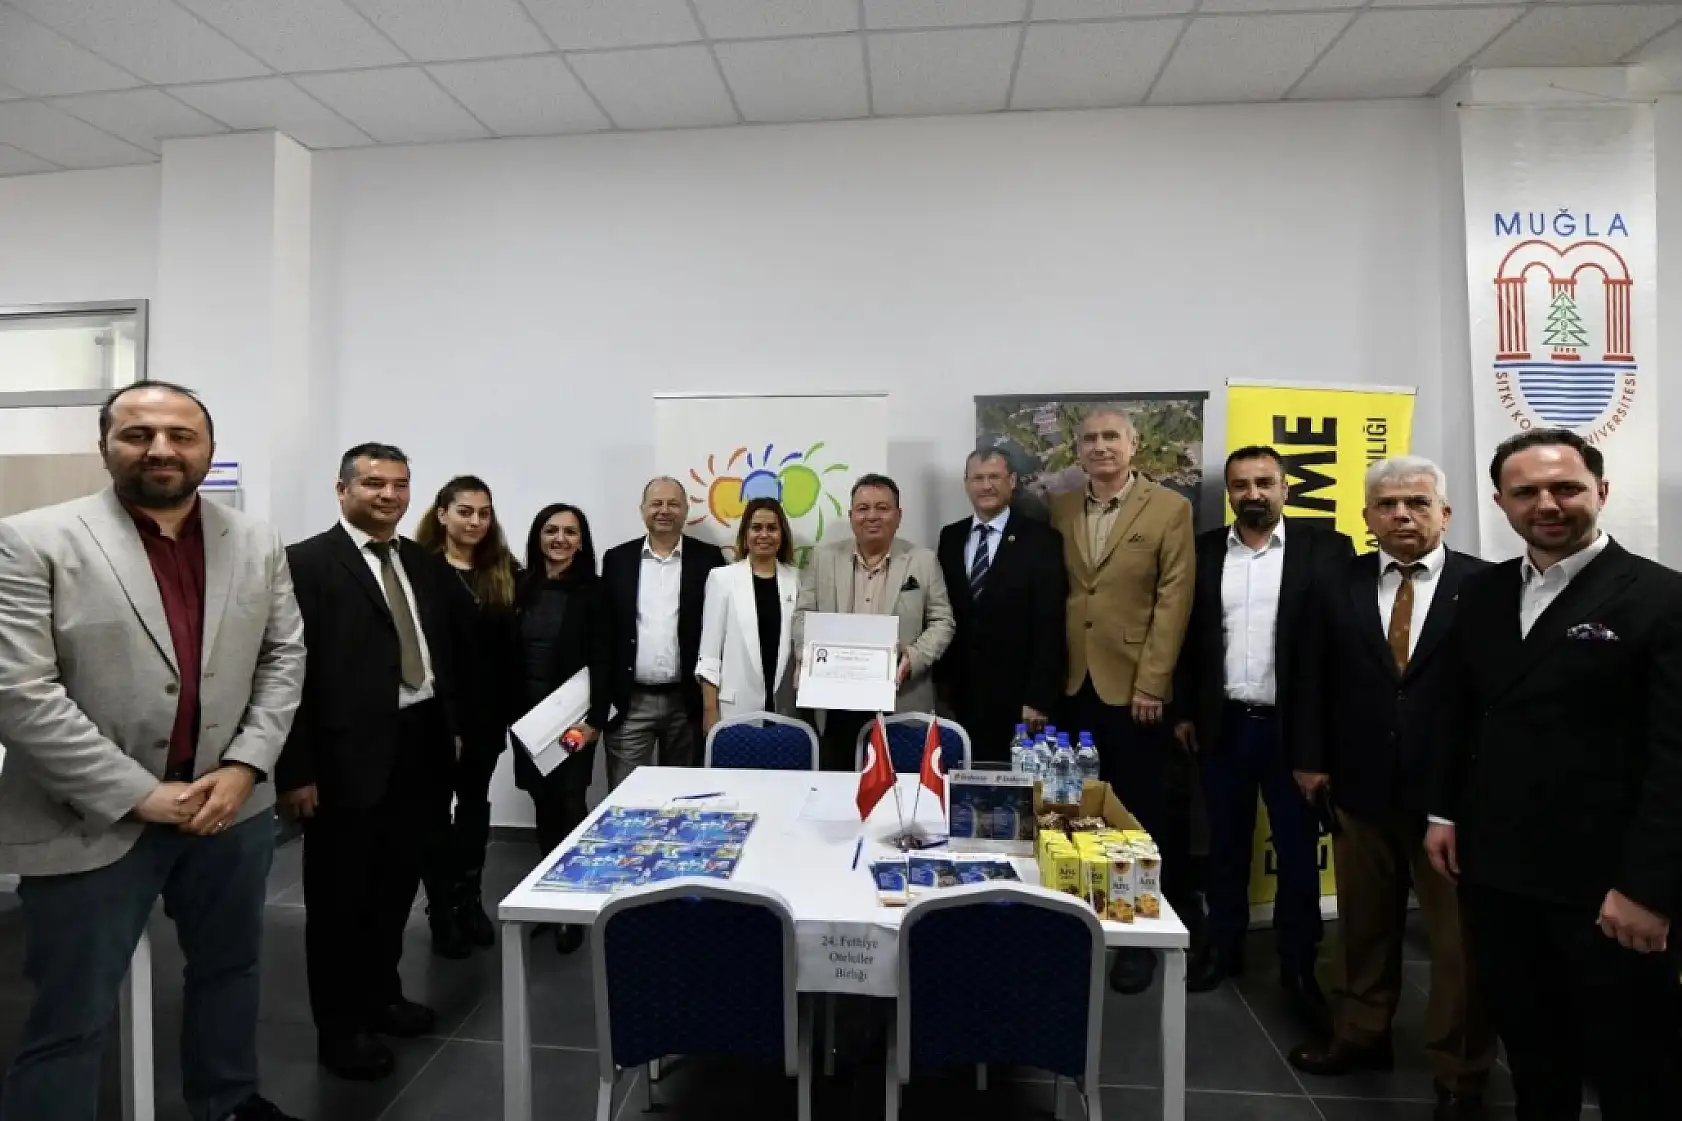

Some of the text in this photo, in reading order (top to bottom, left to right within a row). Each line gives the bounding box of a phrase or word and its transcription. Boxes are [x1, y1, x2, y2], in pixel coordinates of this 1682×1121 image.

[1494, 209, 1629, 237] MUĞLA
[1510, 409, 1531, 430] KO
[1272, 415, 1337, 512] ME
